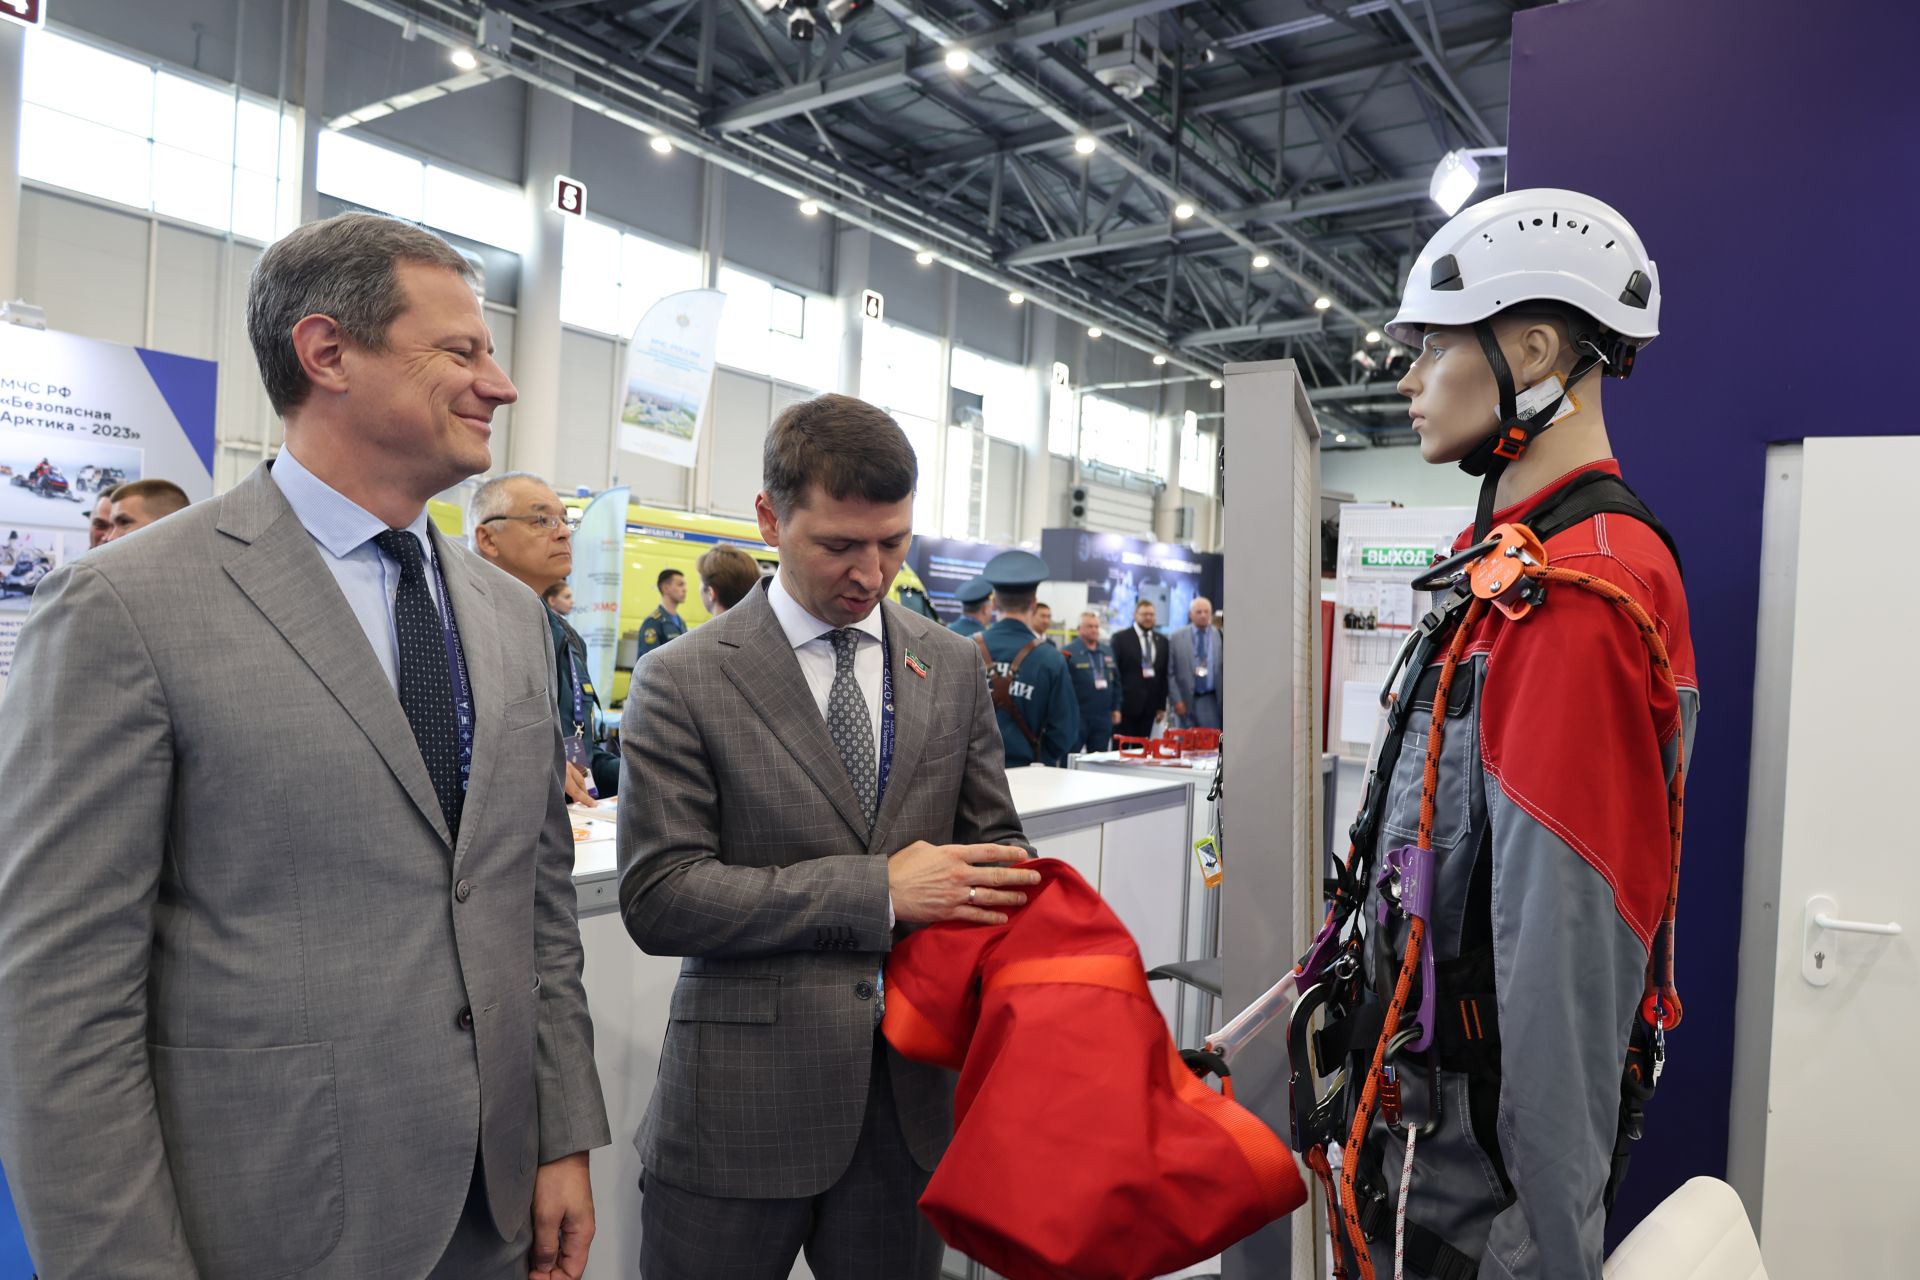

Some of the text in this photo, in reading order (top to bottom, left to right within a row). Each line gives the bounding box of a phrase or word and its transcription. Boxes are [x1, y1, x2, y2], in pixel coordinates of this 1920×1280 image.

[562, 185, 577, 210] 5
[0, 378, 71, 398] МЧС РФ
[0, 396, 112, 421] «Безопасная
[0, 411, 75, 431] Арктика
[92, 423, 141, 440] 2023»
[1367, 549, 1428, 566] ВЫХОД
[453, 633, 469, 696] КОМПЛЕКСНАЯ
